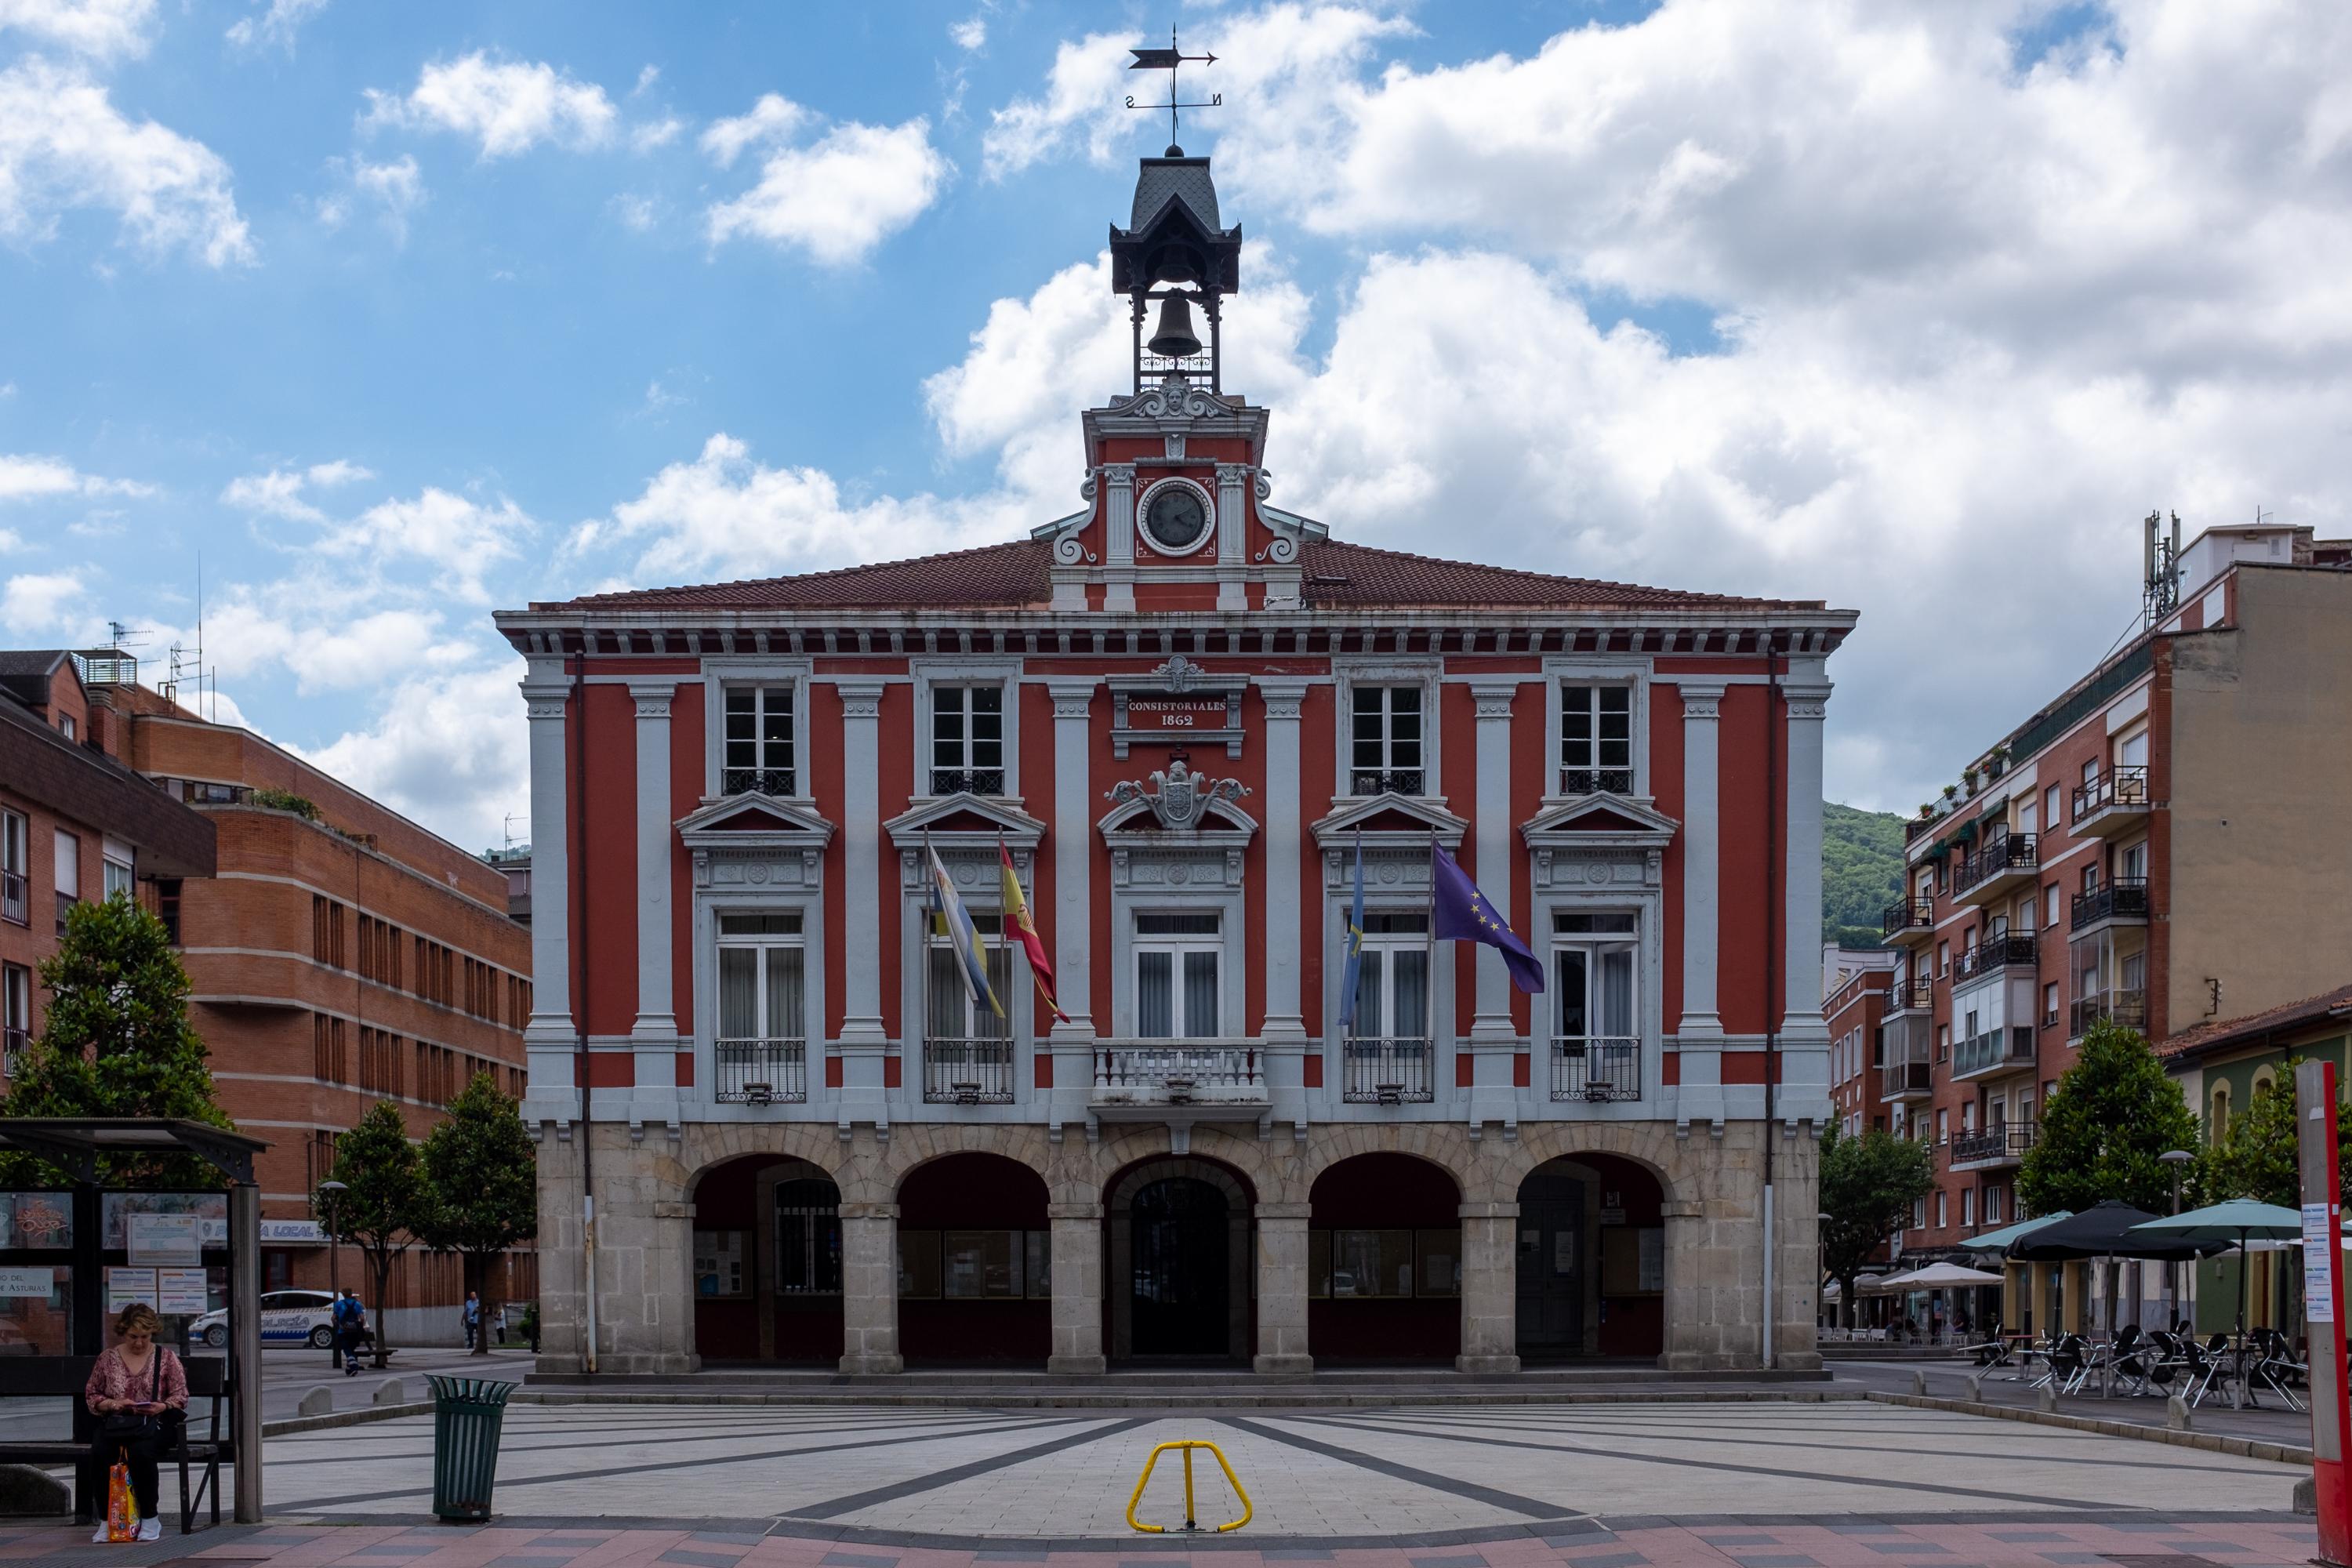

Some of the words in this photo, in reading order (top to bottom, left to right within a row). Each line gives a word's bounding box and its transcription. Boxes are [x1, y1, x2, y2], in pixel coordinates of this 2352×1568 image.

[1129, 702, 1226, 711] CONSISTORIALES
[1162, 715, 1193, 726] 1862
[274, 1225, 314, 1237] LOCAL
